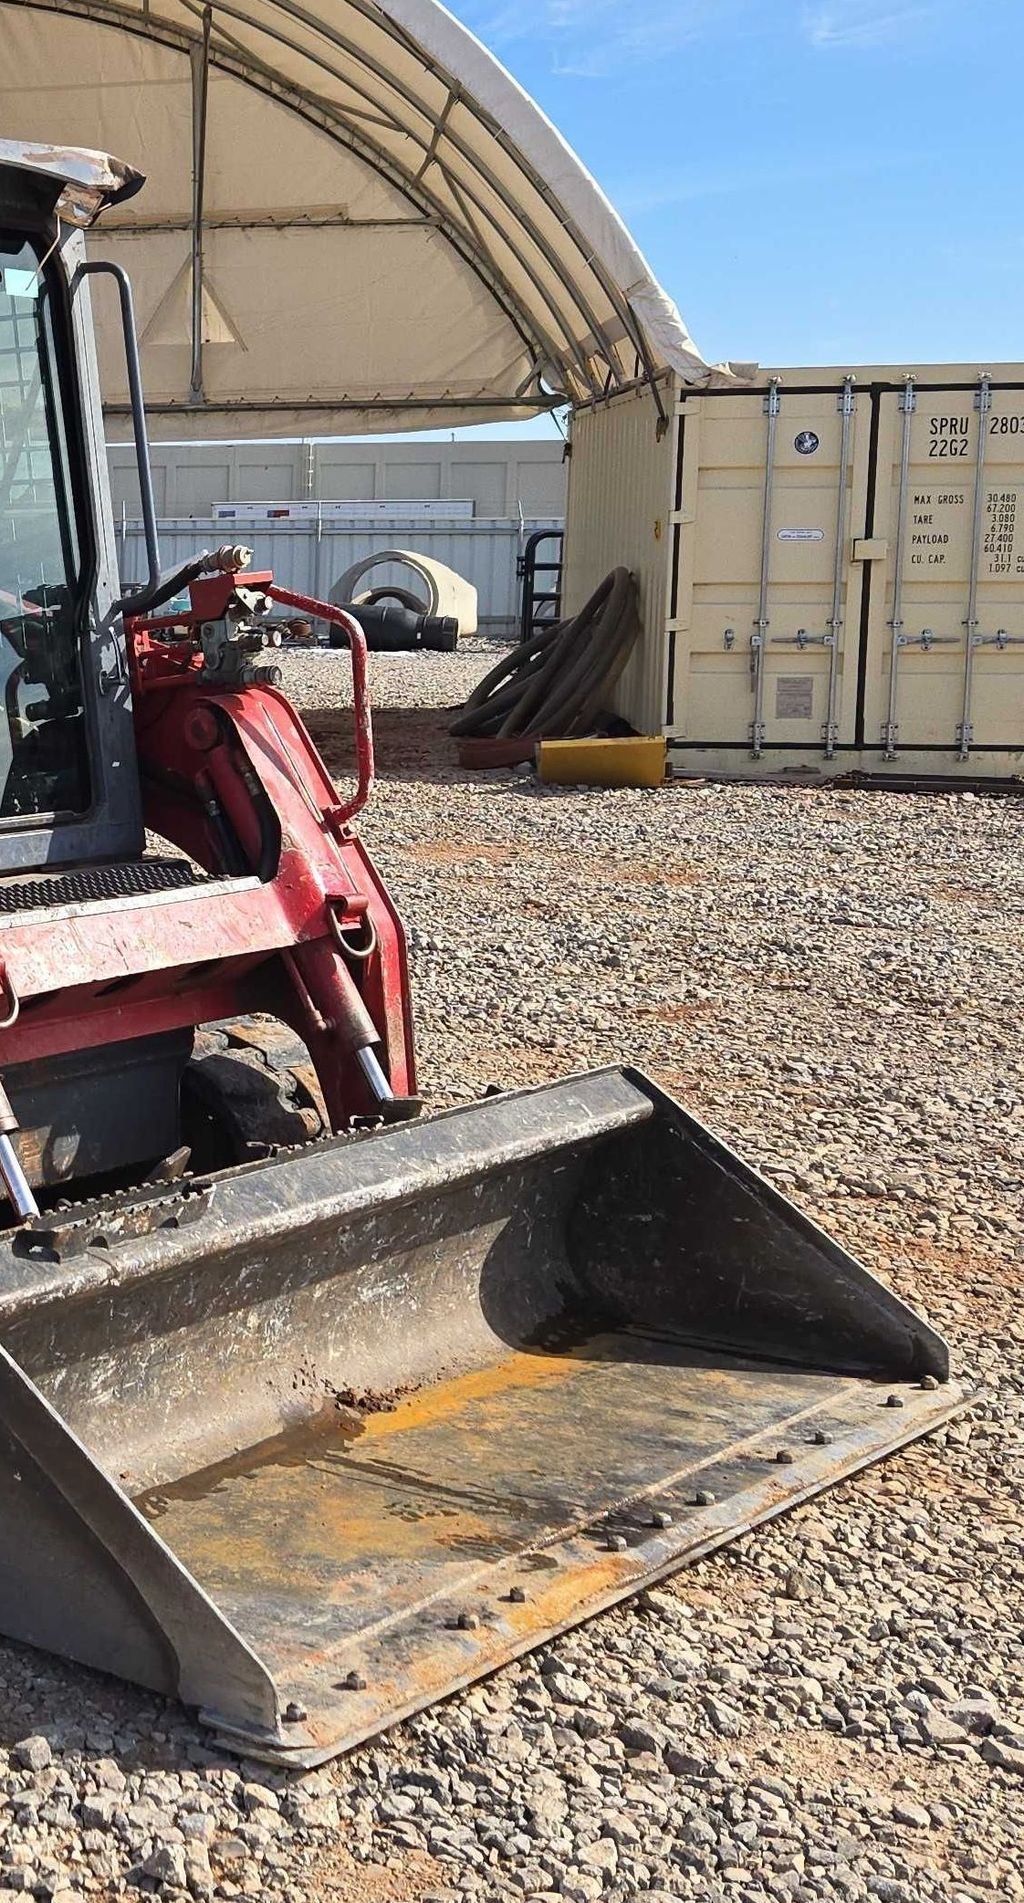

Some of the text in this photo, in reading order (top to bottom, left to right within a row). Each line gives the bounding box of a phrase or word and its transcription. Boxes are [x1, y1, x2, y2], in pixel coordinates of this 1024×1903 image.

[929, 417, 969, 436] SPRU
[929, 438, 969, 457] 22G2
[913, 493, 1017, 505] MAX GROSS 30.480
[986, 503, 1016, 513] 67.200
[913, 513, 1015, 524] TARE 3.080
[990, 523, 1015, 533] 6.790
[911, 533, 1013, 544] PAYLOAD 27.400
[984, 543, 1013, 553] 60.410
